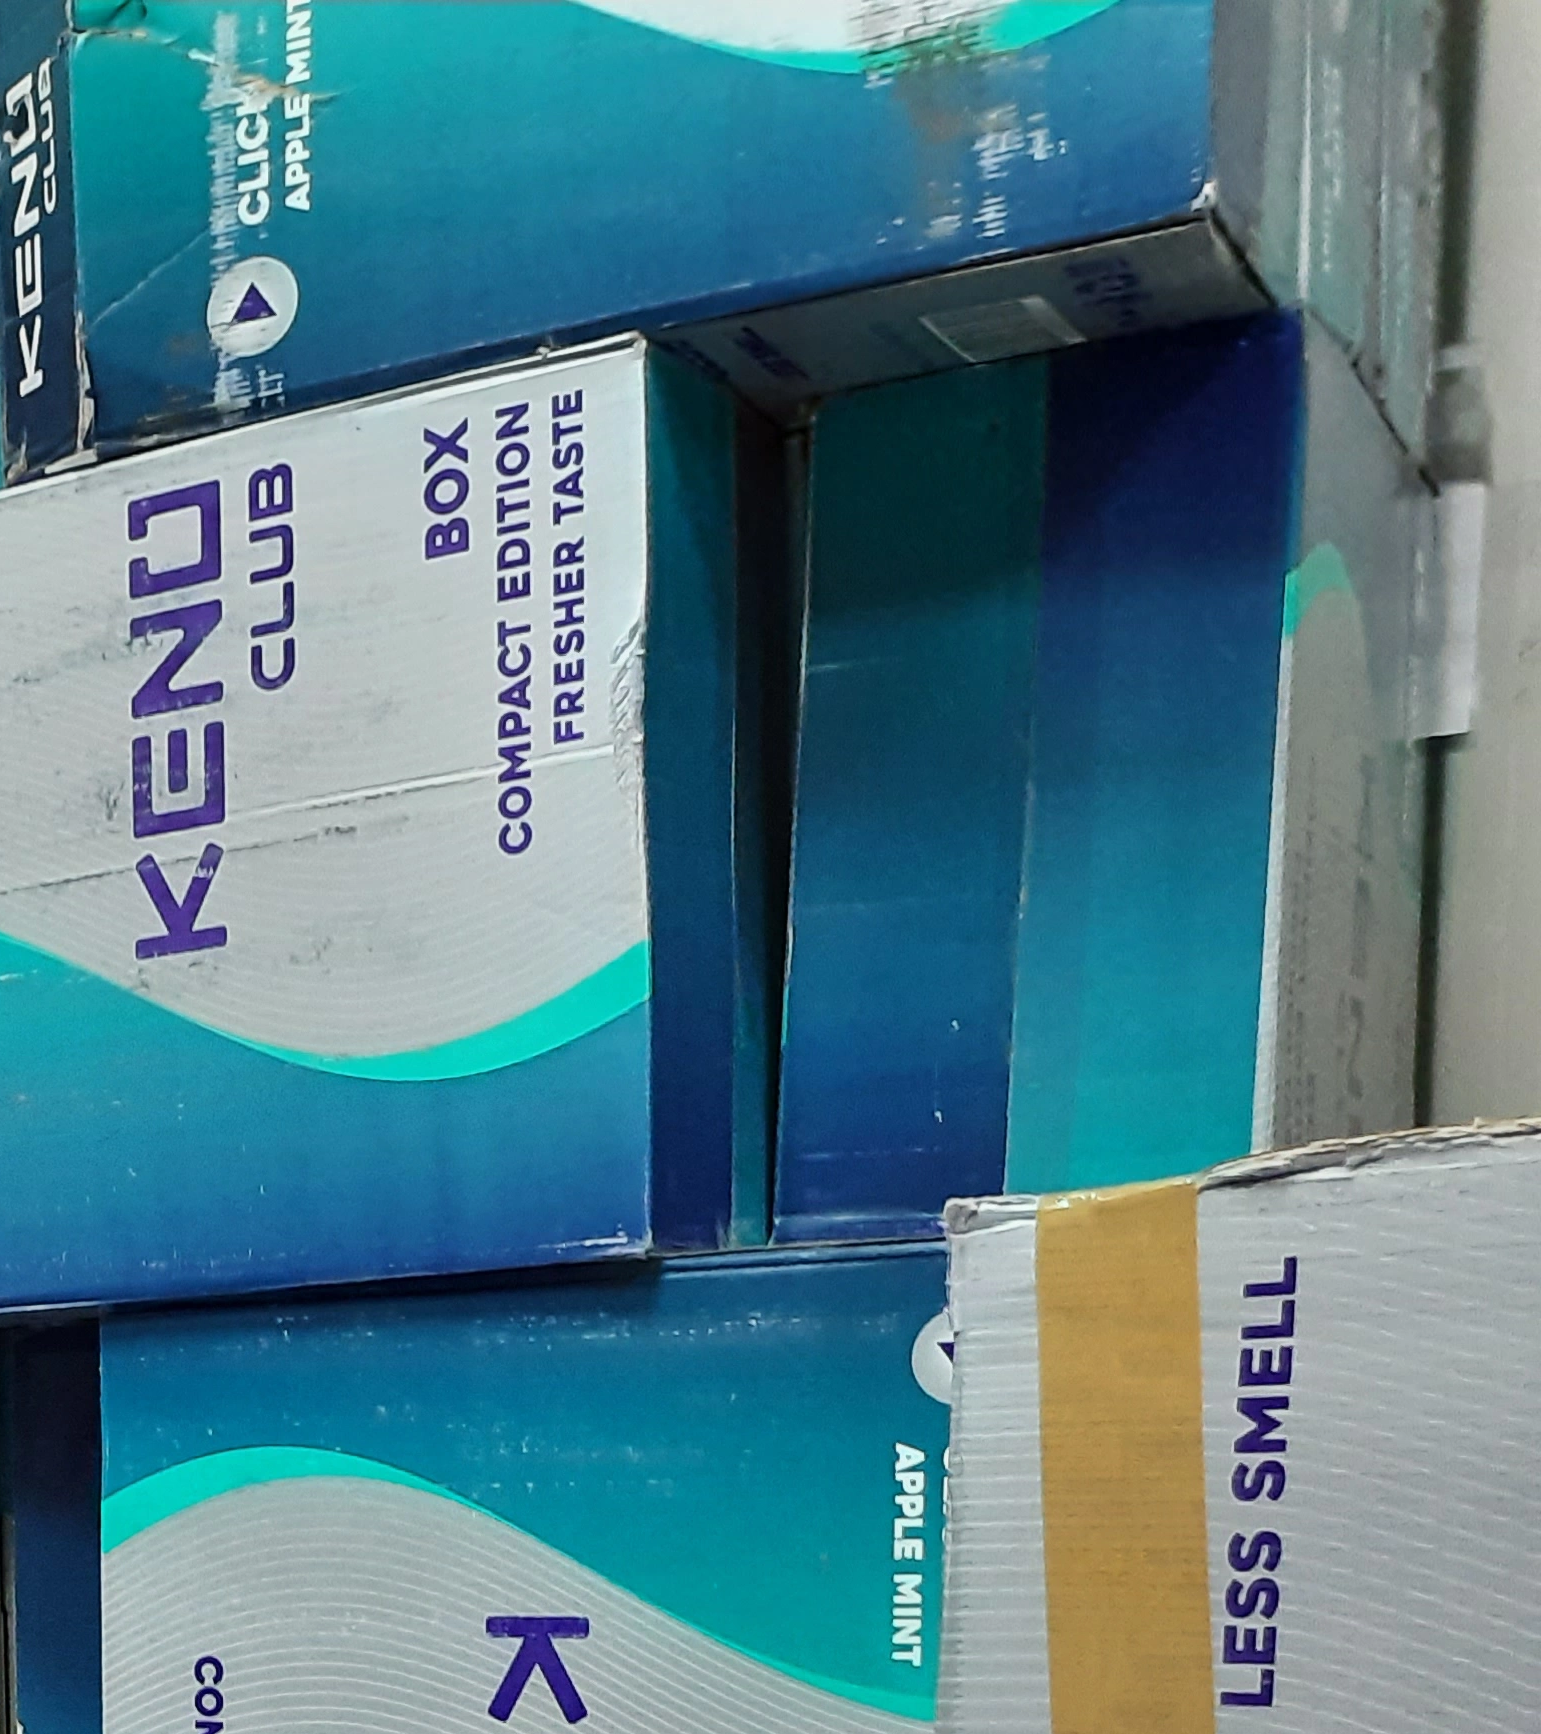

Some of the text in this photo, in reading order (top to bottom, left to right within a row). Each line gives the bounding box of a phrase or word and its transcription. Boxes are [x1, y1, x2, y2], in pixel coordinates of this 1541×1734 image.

[5, 72, 45, 397] KENO
[237, 85, 269, 226] CLICK
[284, 93, 311, 211] APPLE
[248, 463, 296, 691] CLUB
[423, 419, 470, 560] BOX
[552, 389, 586, 744] FRESHER TASTE
[127, 479, 228, 961] KENO
[496, 402, 533, 855] COMPACT EDITION
[890, 1441, 925, 1667] APPLE MINT
[1220, 1255, 1299, 1708] LESS SMELL
